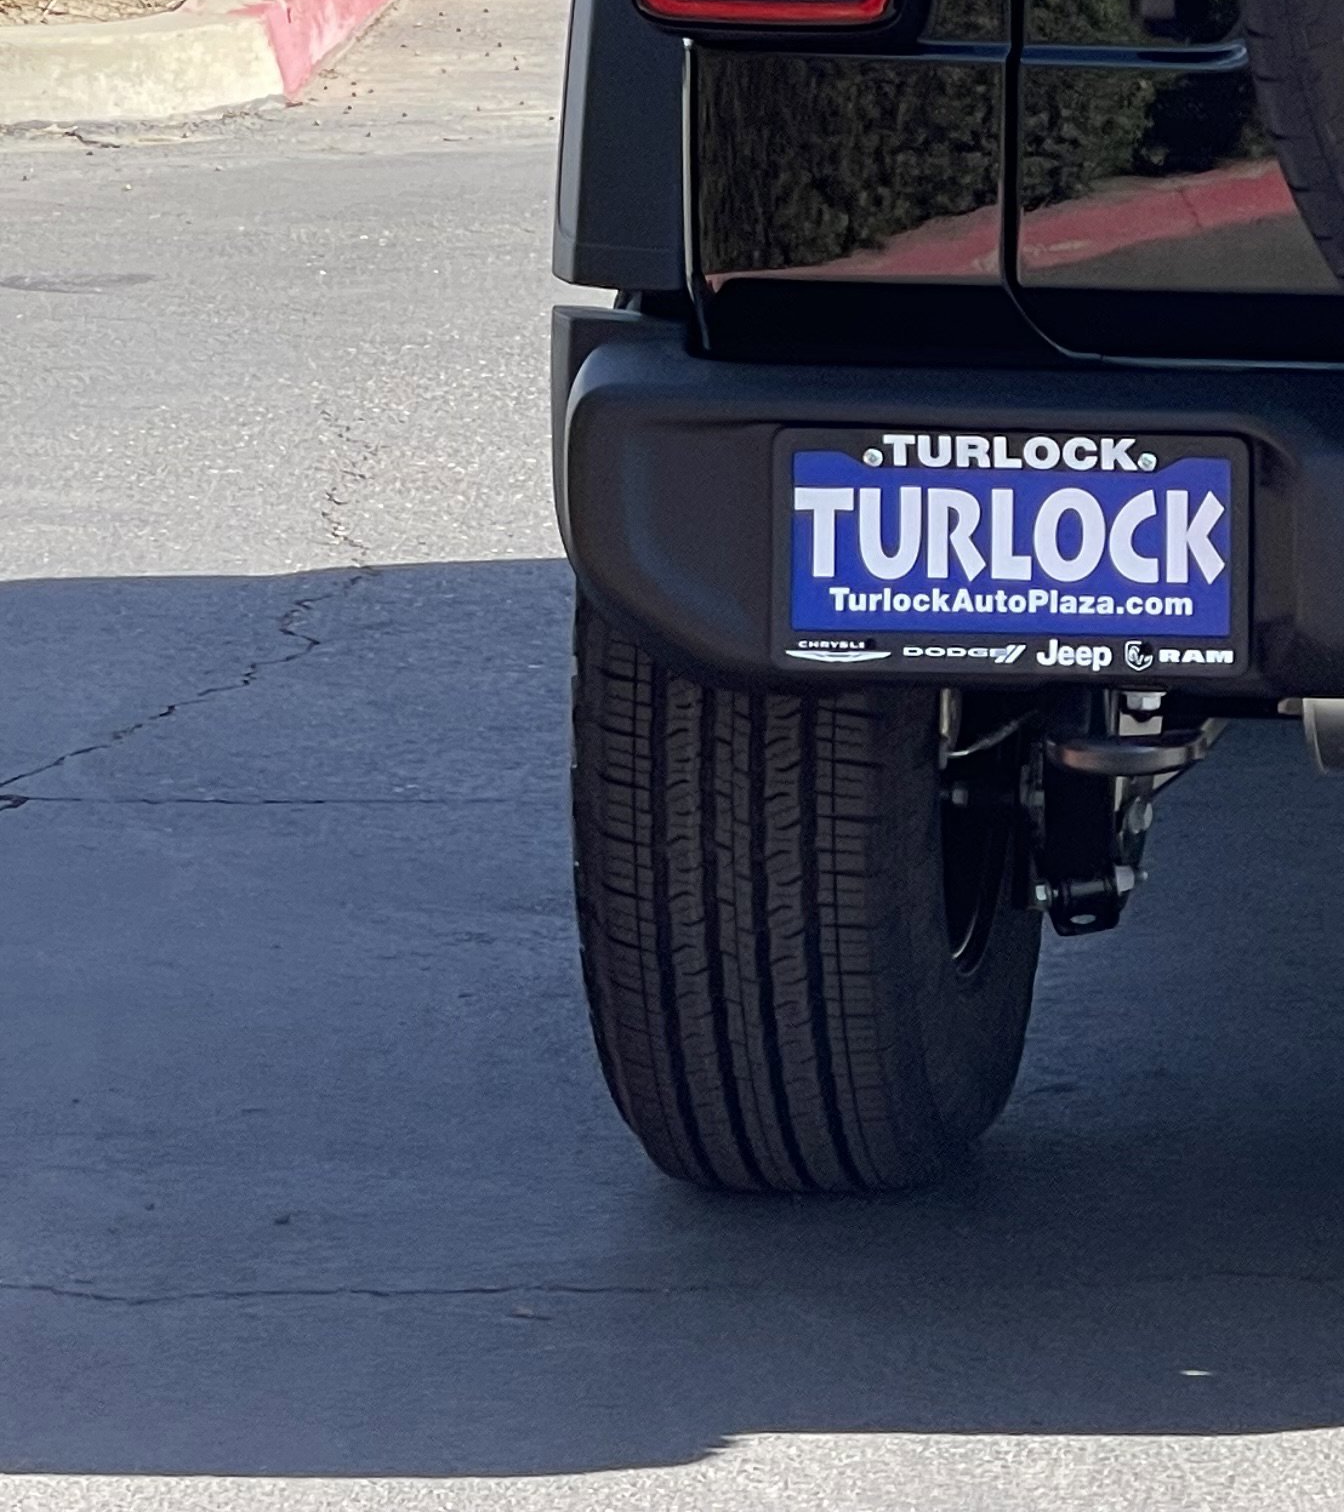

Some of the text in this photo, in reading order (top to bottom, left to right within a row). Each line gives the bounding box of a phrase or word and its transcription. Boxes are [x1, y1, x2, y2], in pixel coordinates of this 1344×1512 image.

[883, 434, 1138, 472] TURLOCK
[794, 486, 1226, 585] TURLOCK
[829, 587, 1194, 616] TurlockAutoPlaza.com
[798, 639, 1234, 671] CHRYSLE DODGE Jeep RAM
